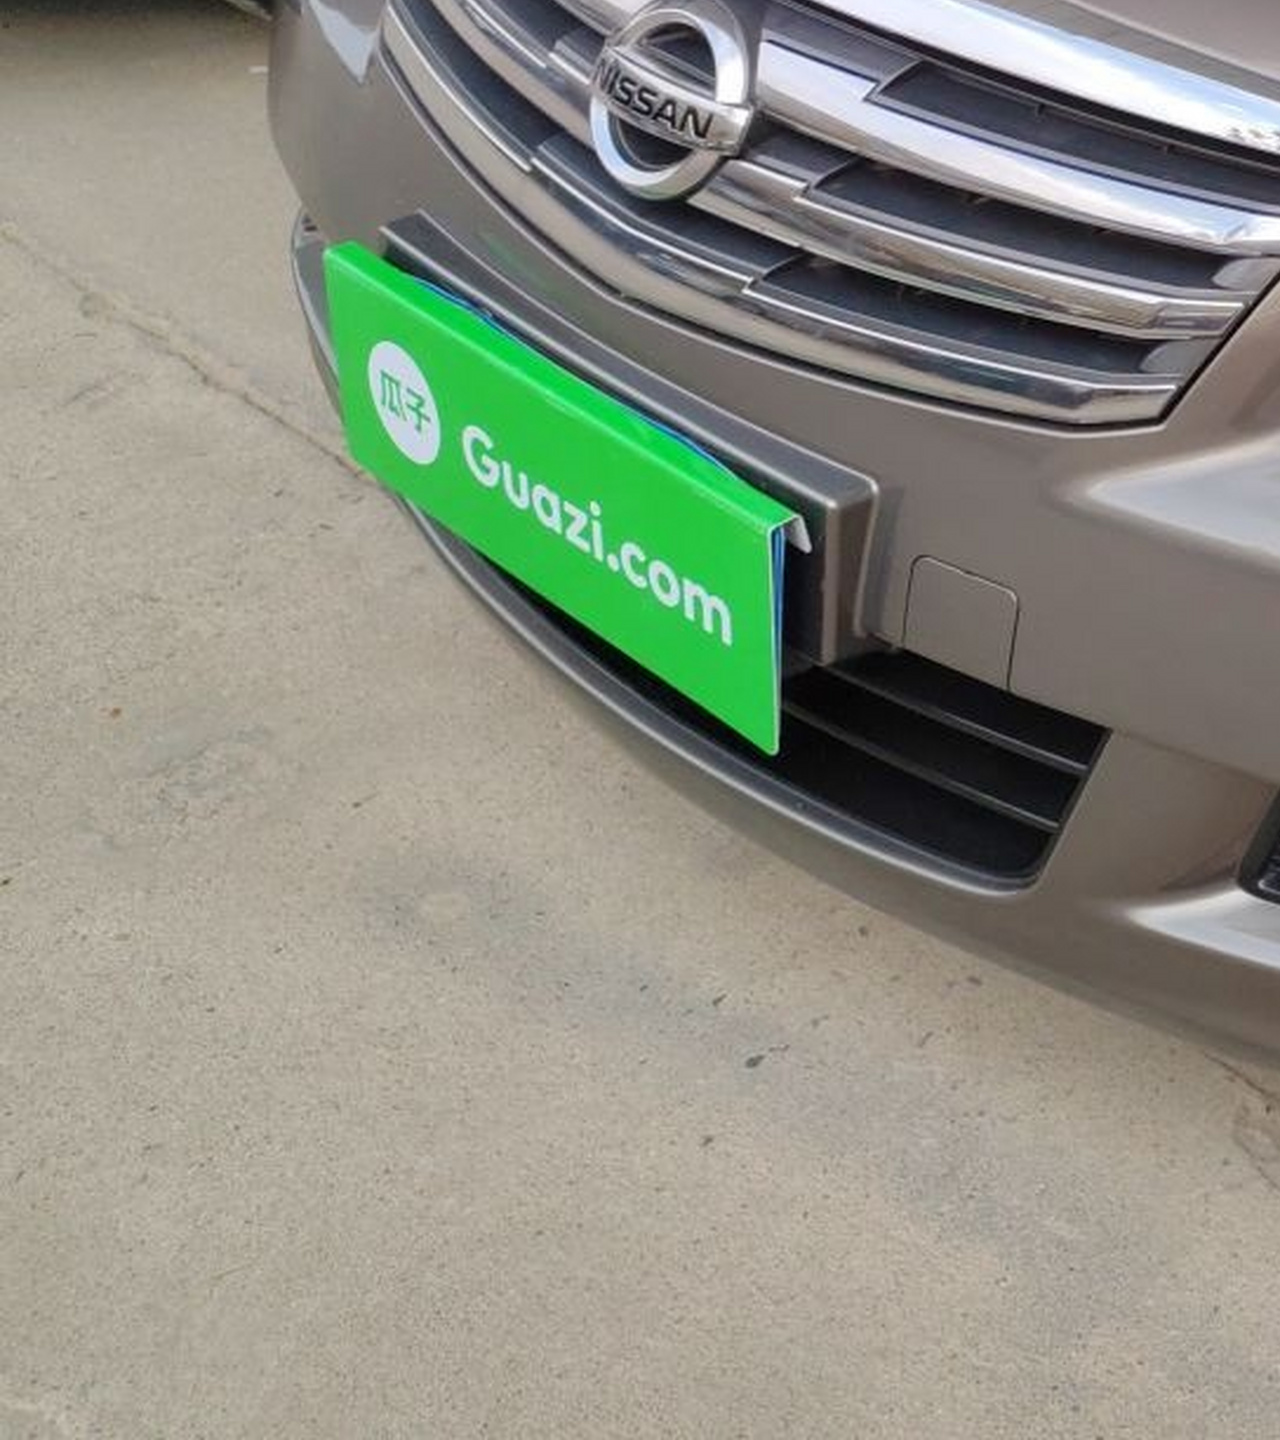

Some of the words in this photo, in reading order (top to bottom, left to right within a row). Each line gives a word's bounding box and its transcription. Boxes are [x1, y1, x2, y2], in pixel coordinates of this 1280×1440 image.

[594, 58, 713, 139] NISSAN
[379, 368, 432, 435] 瓜子
[461, 424, 733, 647] Guazi.com
